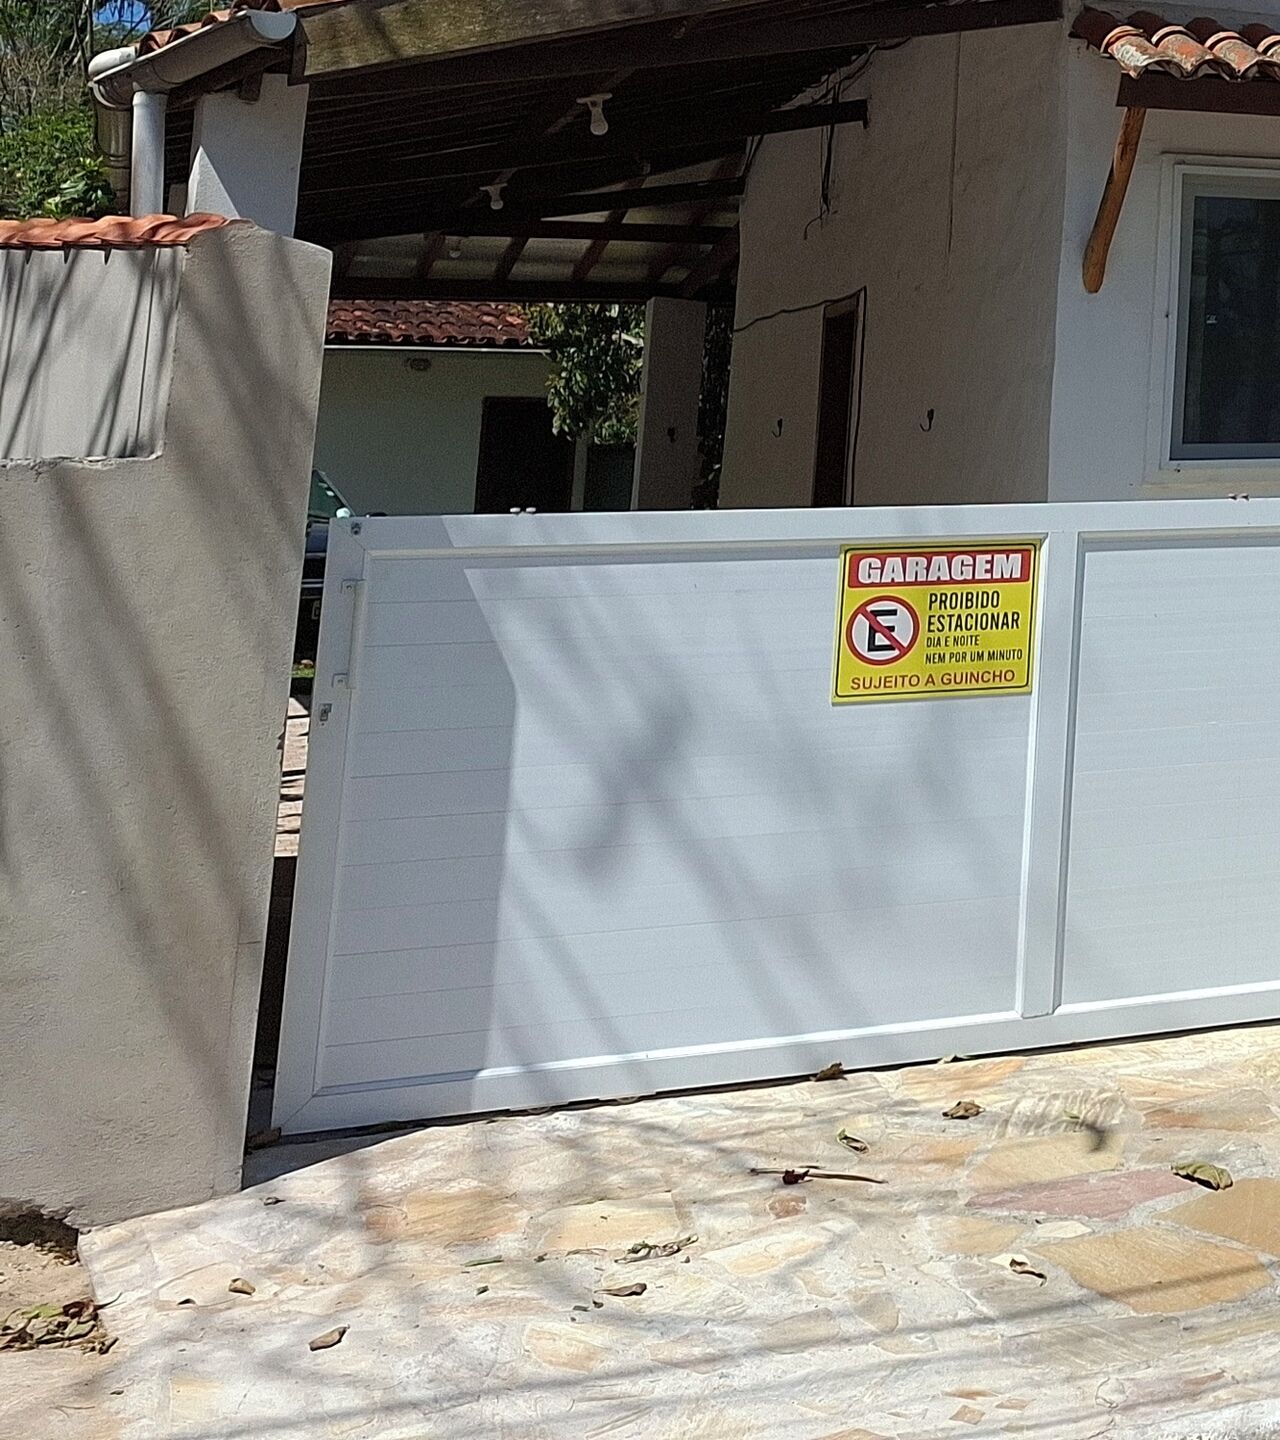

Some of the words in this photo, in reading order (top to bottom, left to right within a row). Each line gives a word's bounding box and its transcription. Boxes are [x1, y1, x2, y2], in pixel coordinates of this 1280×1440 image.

[858, 553, 1022, 584] GARAGEM
[929, 591, 1000, 610] PROIBIDO
[927, 612, 1020, 633] ESTACIONAR
[926, 636, 942, 648] DIA
[945, 637, 950, 647] E
[953, 635, 980, 647] NOITE
[925, 652, 946, 664] NEM
[949, 652, 967, 663] POR
[970, 651, 984, 662] UM
[987, 649, 1023, 661] MINUTO
[851, 675, 920, 690] SUJEITO
[925, 676, 936, 686] A
[941, 670, 1015, 685] GUINCHO
